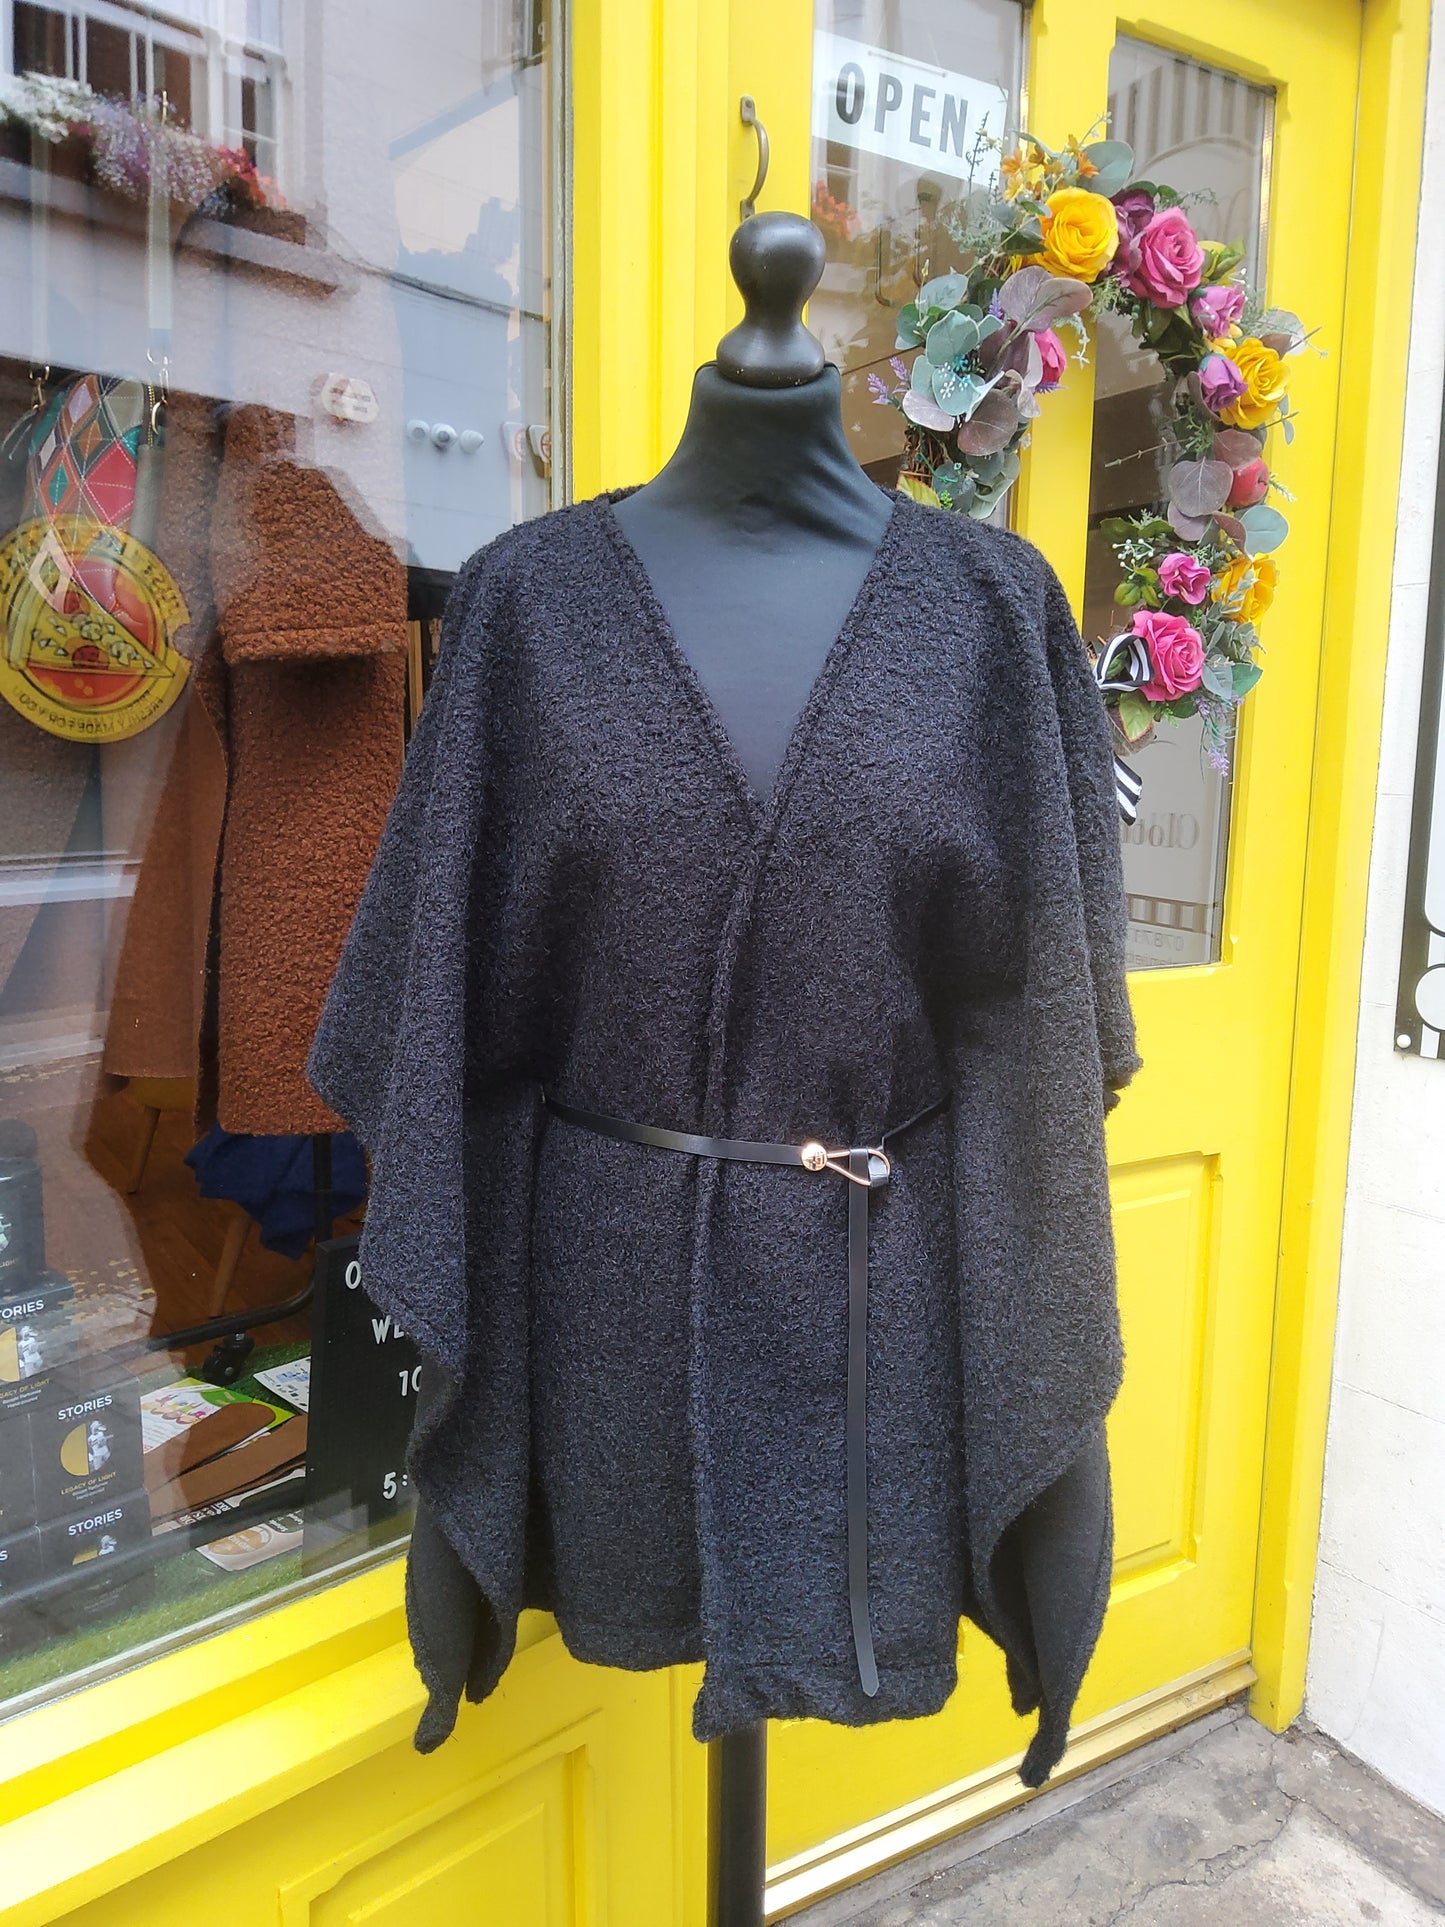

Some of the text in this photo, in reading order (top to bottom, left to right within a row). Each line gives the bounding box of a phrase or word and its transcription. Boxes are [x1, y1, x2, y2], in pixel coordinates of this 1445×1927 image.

[835, 62, 968, 158] OPEN
[0, 1299, 44, 1319] ORIES
[58, 1394, 113, 1420] STORIES
[61, 1483, 87, 1495] LEGACY
[98, 1471, 116, 1482] LIGHT
[68, 1508, 123, 1536] STORIES
